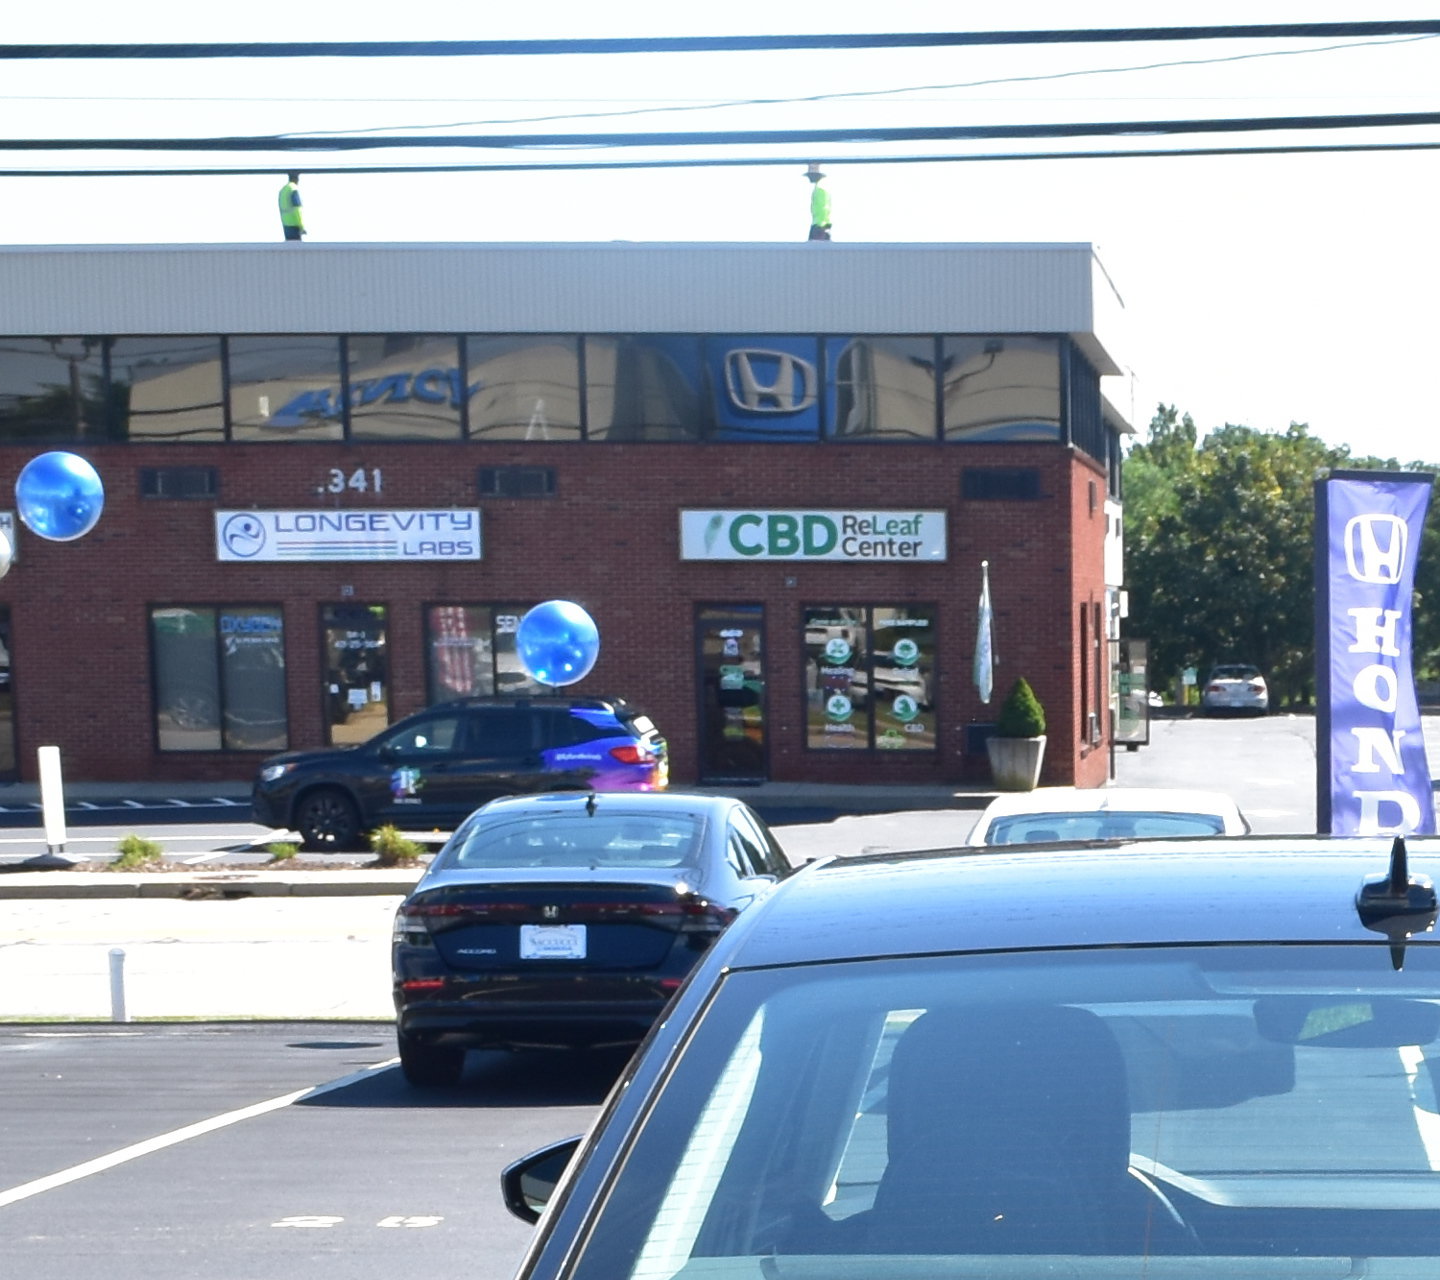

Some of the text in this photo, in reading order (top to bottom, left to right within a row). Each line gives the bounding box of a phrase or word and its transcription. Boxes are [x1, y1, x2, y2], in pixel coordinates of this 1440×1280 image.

[275, 513, 472, 532] LONGEVITY
[842, 514, 923, 535] ReLeaf
[729, 514, 838, 556] CBD
[403, 541, 473, 555] LABS
[842, 537, 922, 557] Center
[1347, 607, 1421, 835] HOND
